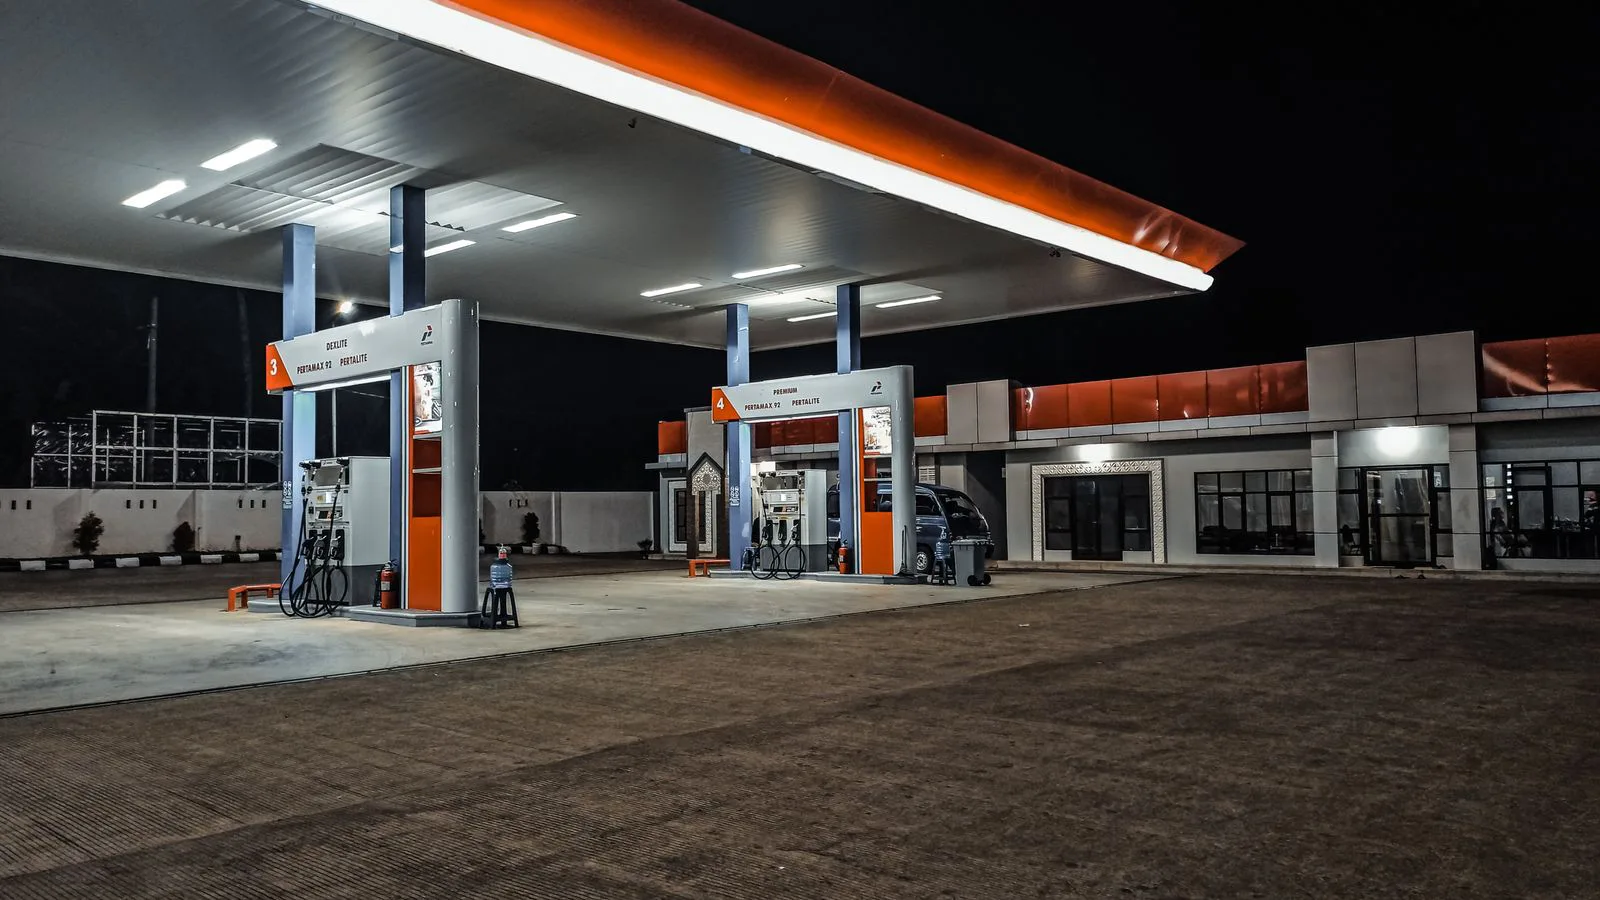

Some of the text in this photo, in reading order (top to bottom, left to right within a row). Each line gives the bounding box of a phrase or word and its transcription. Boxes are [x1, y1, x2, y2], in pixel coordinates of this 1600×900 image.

[326, 339, 348, 351] DEXLITE
[340, 354, 368, 367] PERTALITE
[270, 359, 278, 376] 3
[297, 360, 332, 375] PERTAMAX 92
[773, 387, 798, 395] PREMIUM
[716, 398, 724, 410] 4
[744, 403, 773, 411] PERTAMAX
[792, 398, 820, 406] PERTALITE
